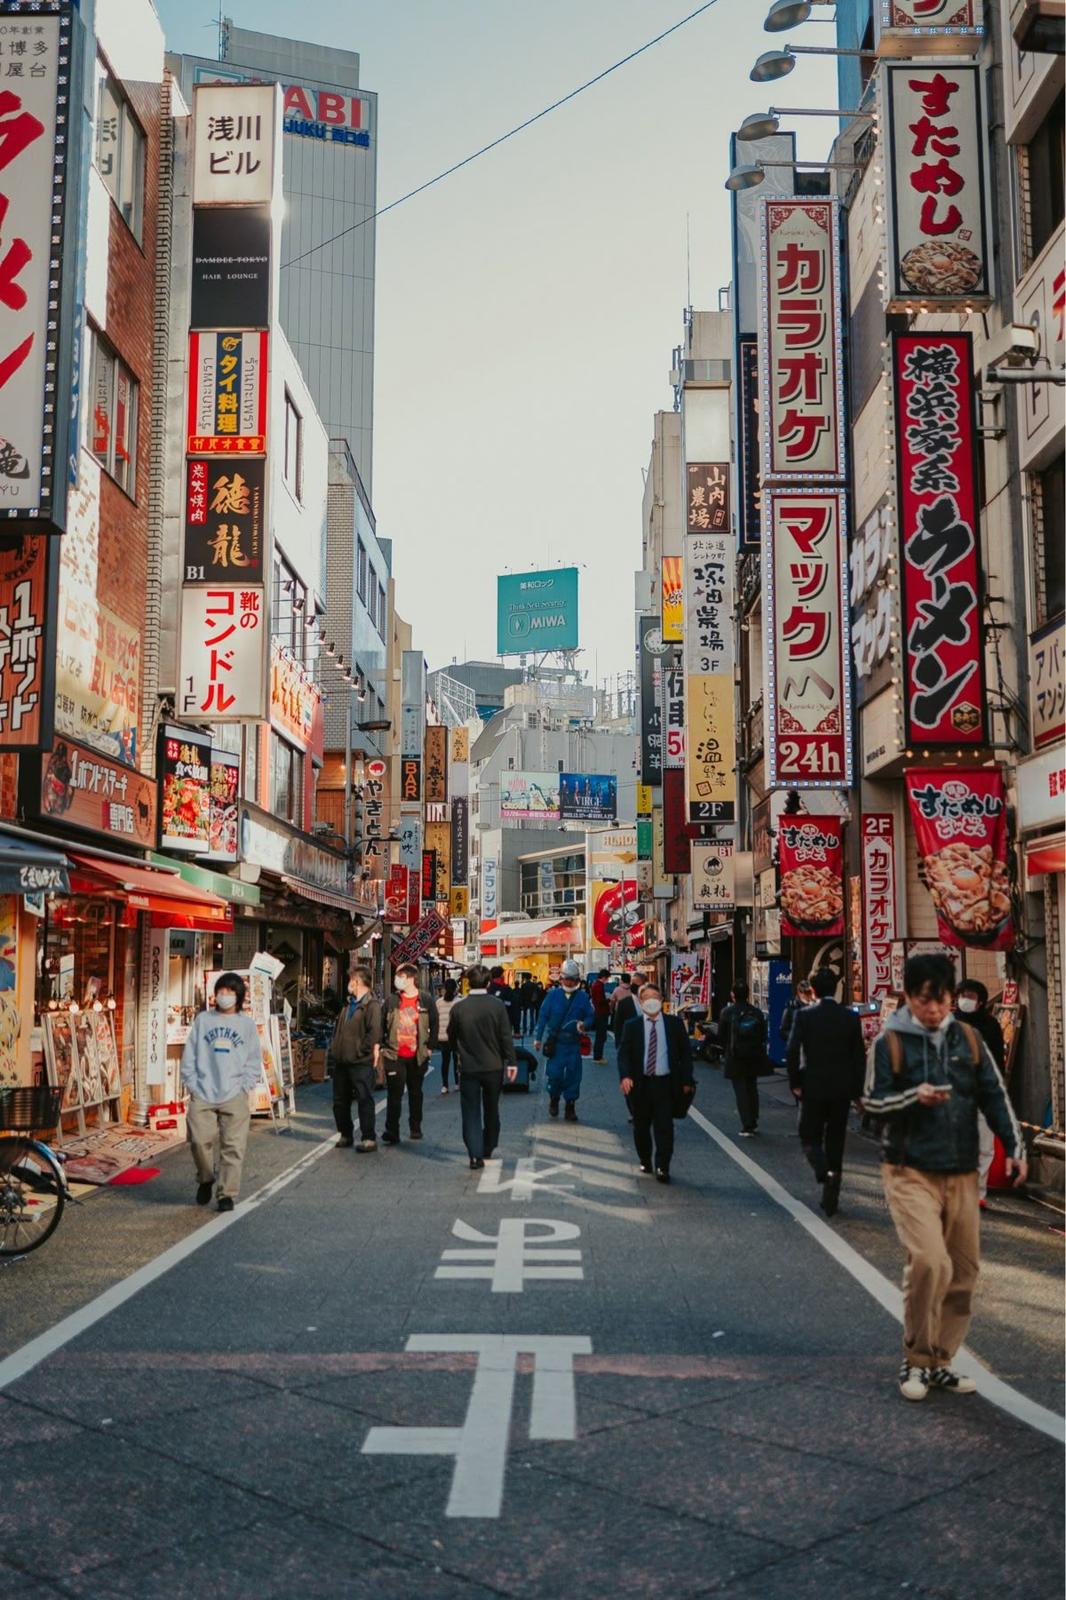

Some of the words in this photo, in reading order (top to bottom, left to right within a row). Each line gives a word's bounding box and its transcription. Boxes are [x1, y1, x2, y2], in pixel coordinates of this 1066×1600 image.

[0, 41, 48, 56] 博多
[0, 63, 47, 78] 屋台
[208, 115, 261, 141] 浅川
[209, 152, 261, 175] ビル
[908, 73, 964, 236] すためし
[777, 243, 830, 463] カラオケ
[217, 354, 239, 433] タイ料理
[189, 463, 206, 523] 炭火焼肉
[707, 466, 726, 506] 山内
[689, 486, 709, 528] 農場
[693, 541, 726, 551] 北海道
[186, 566, 206, 580] B1
[779, 506, 831, 661] マック
[239, 591, 260, 630] 靴の
[530, 615, 566, 630] MIWA
[693, 563, 725, 651] 塚田農場
[11, 580, 42, 732] 1ポンド
[200, 591, 237, 712] コンドル
[700, 657, 720, 672] 3F
[69, 750, 129, 800] 1ポンドステーキ
[779, 741, 841, 773] 24h
[404, 761, 417, 798] BAR
[365, 779, 384, 856] やきとん
[699, 802, 724, 817] 2F
[911, 784, 1003, 819] すためし
[781, 825, 839, 848] すためし
[866, 818, 890, 834] 2F
[717, 847, 732, 856] B1
[484, 860, 498, 918] アラジン
